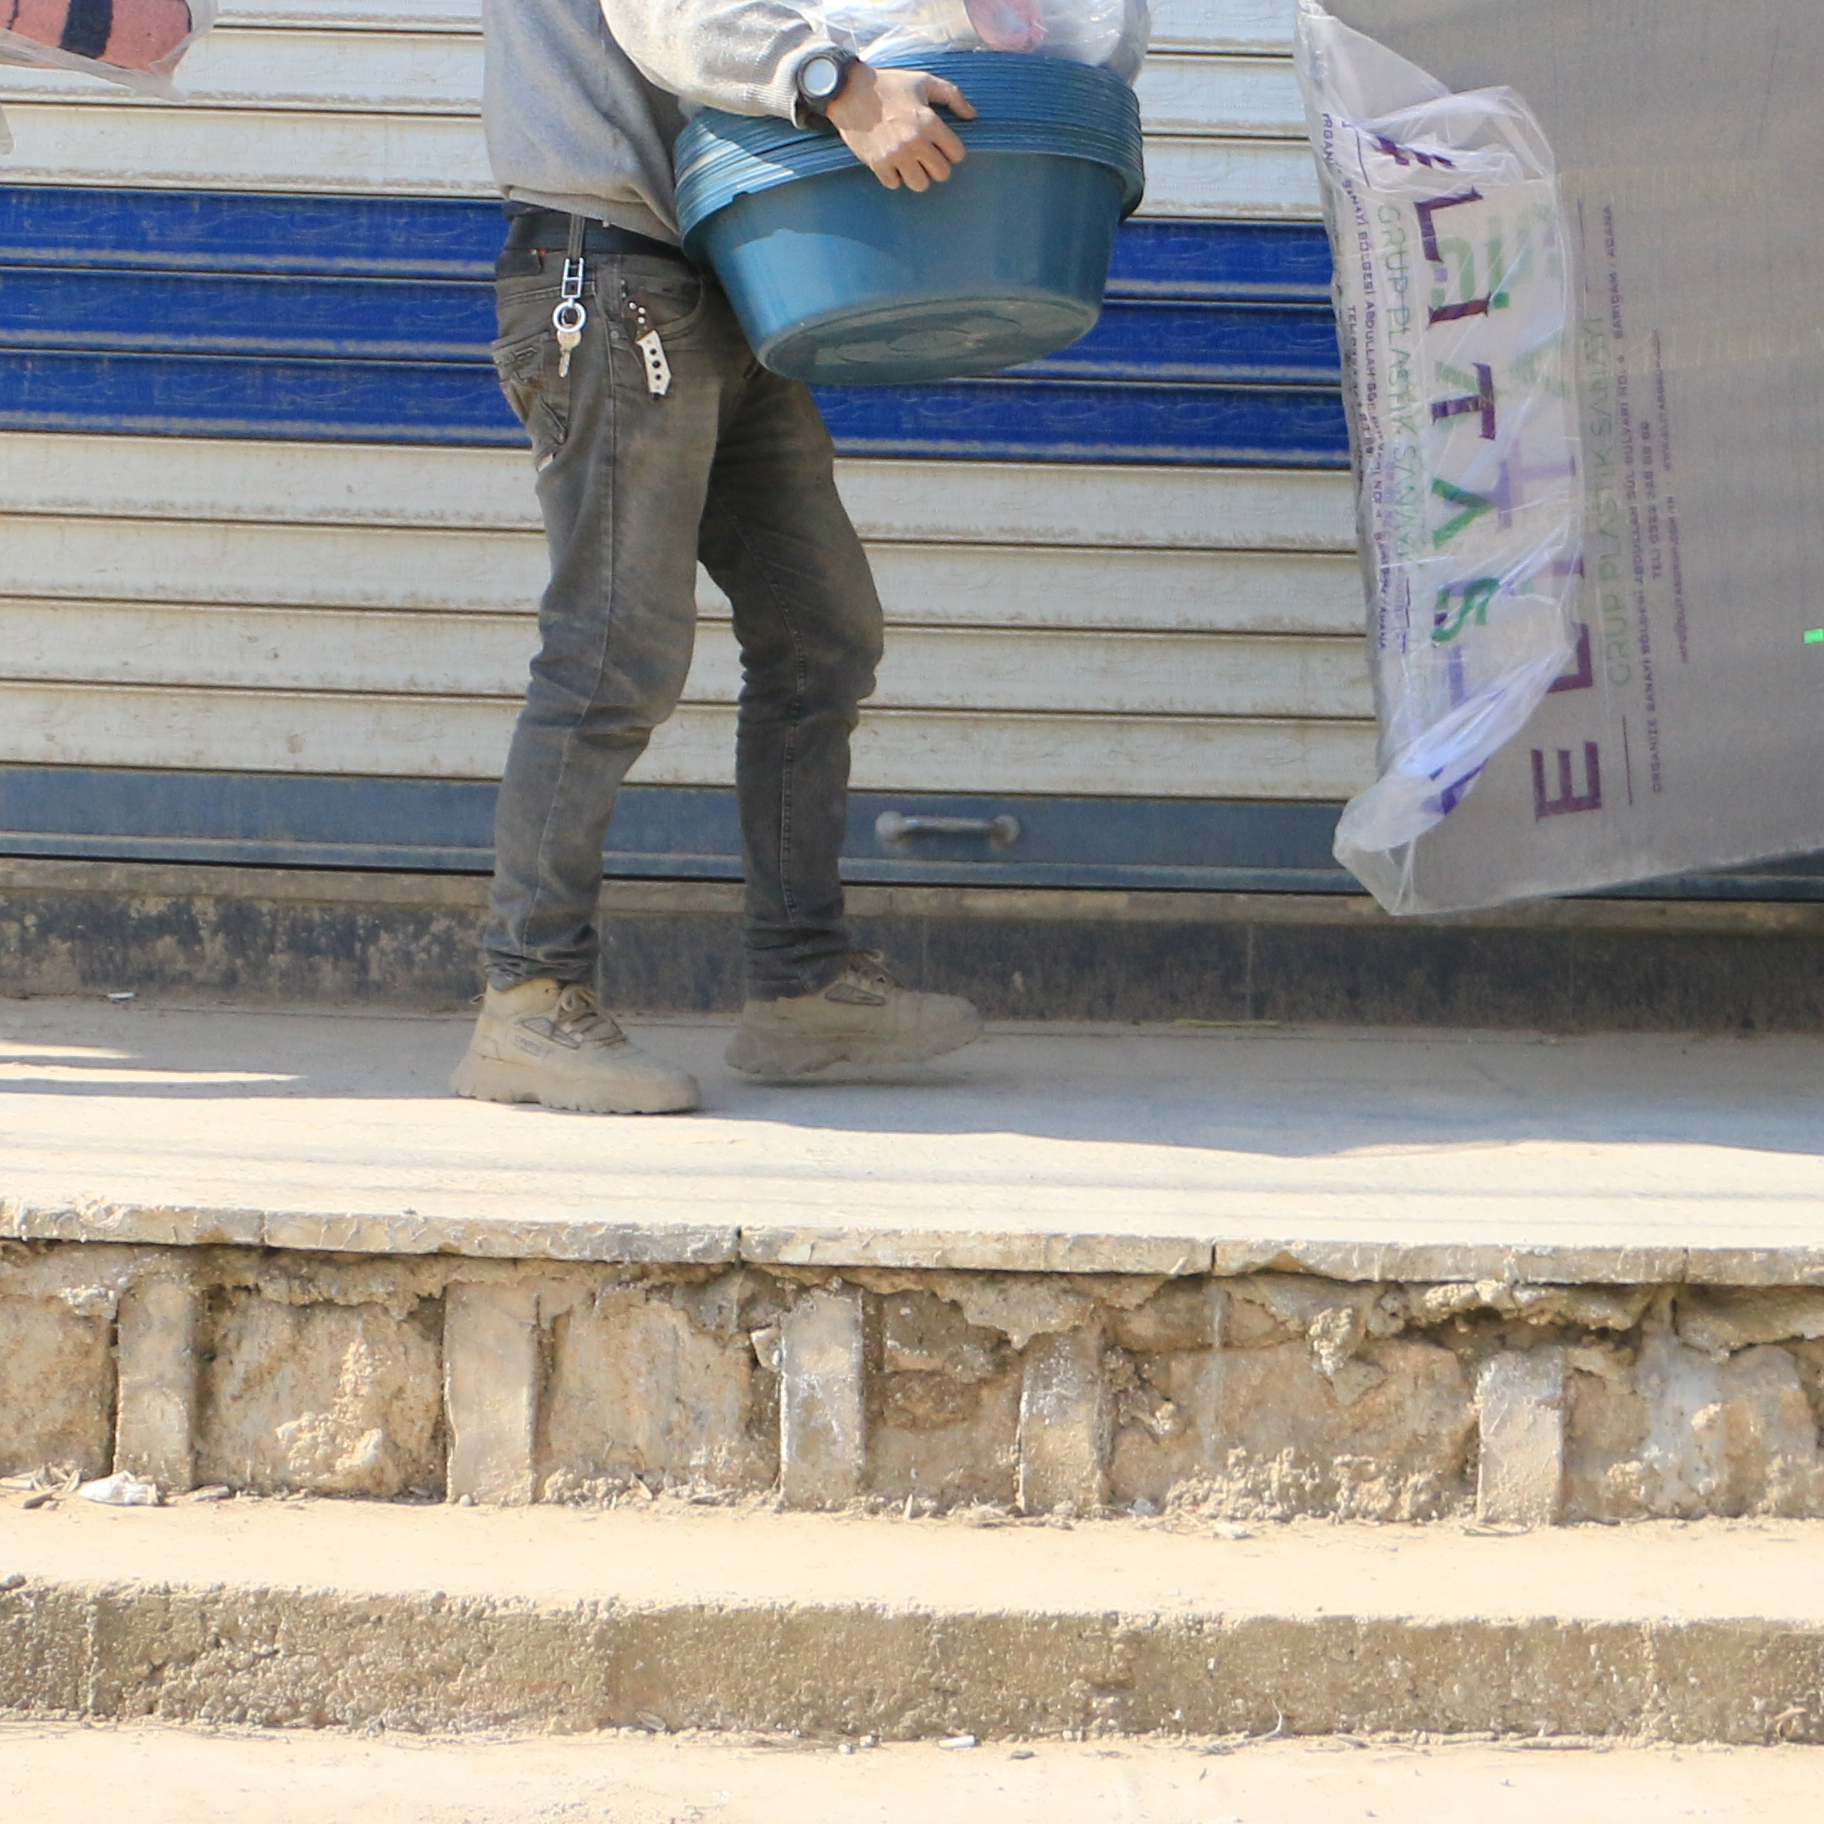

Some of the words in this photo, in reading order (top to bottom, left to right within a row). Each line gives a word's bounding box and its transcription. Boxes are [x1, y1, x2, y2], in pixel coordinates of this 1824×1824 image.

[1359, 231, 1376, 295] BÖLGESİ
[1378, 205, 1409, 293] GRUP
[1601, 204, 1615, 257] ADANA
[1364, 300, 1379, 377] ABDULLAH
